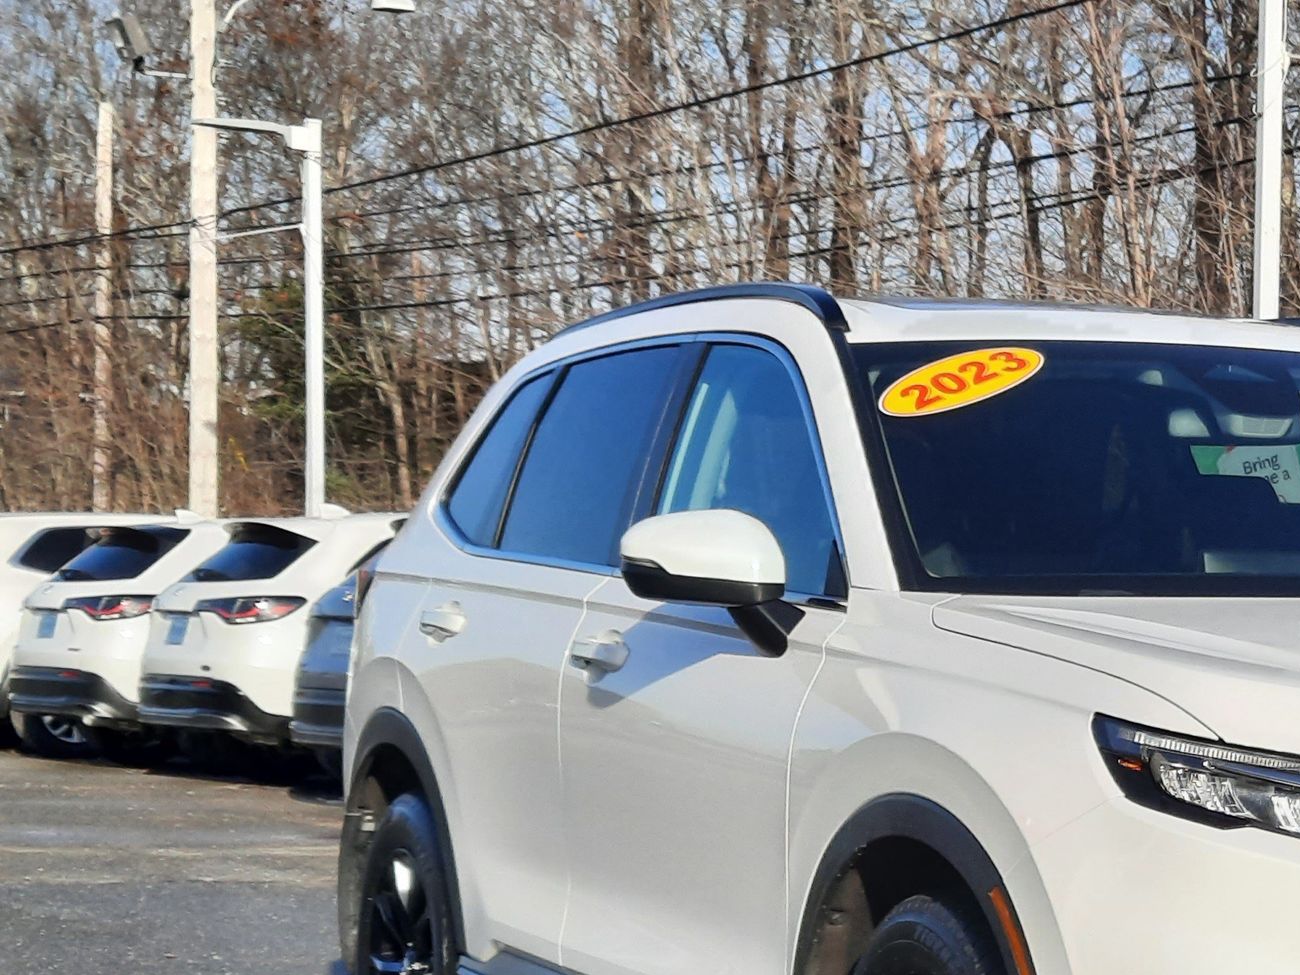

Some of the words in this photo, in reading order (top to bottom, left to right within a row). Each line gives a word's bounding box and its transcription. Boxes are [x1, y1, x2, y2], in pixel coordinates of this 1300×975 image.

[900, 351, 1030, 410] 2023
[1242, 454, 1281, 475] Bring
[1282, 470, 1292, 481] a
